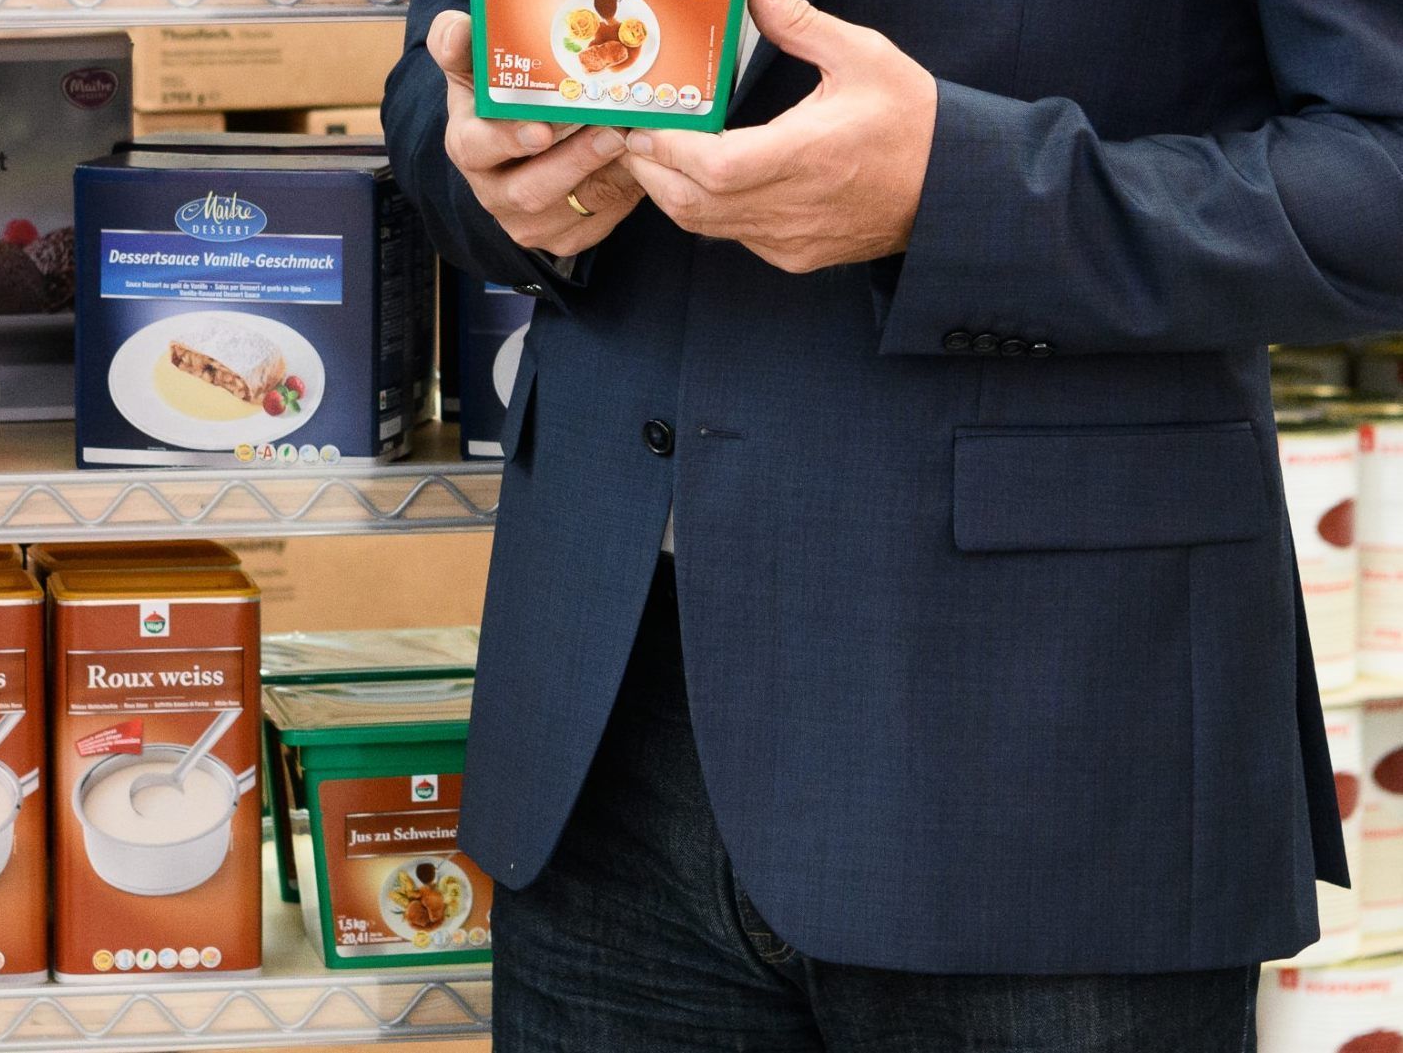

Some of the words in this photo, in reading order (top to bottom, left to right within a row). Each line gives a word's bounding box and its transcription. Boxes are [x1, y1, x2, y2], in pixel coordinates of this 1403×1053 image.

[192, 224, 250, 236] DESSERT
[109, 249, 199, 266] Dessertsauce
[203, 251, 335, 270] Vanille-Geschmack
[87, 665, 155, 689] Roux
[158, 664, 225, 686] weiss
[349, 829, 372, 847] Jus
[374, 831, 391, 842] zu
[393, 825, 459, 842] Schweine
